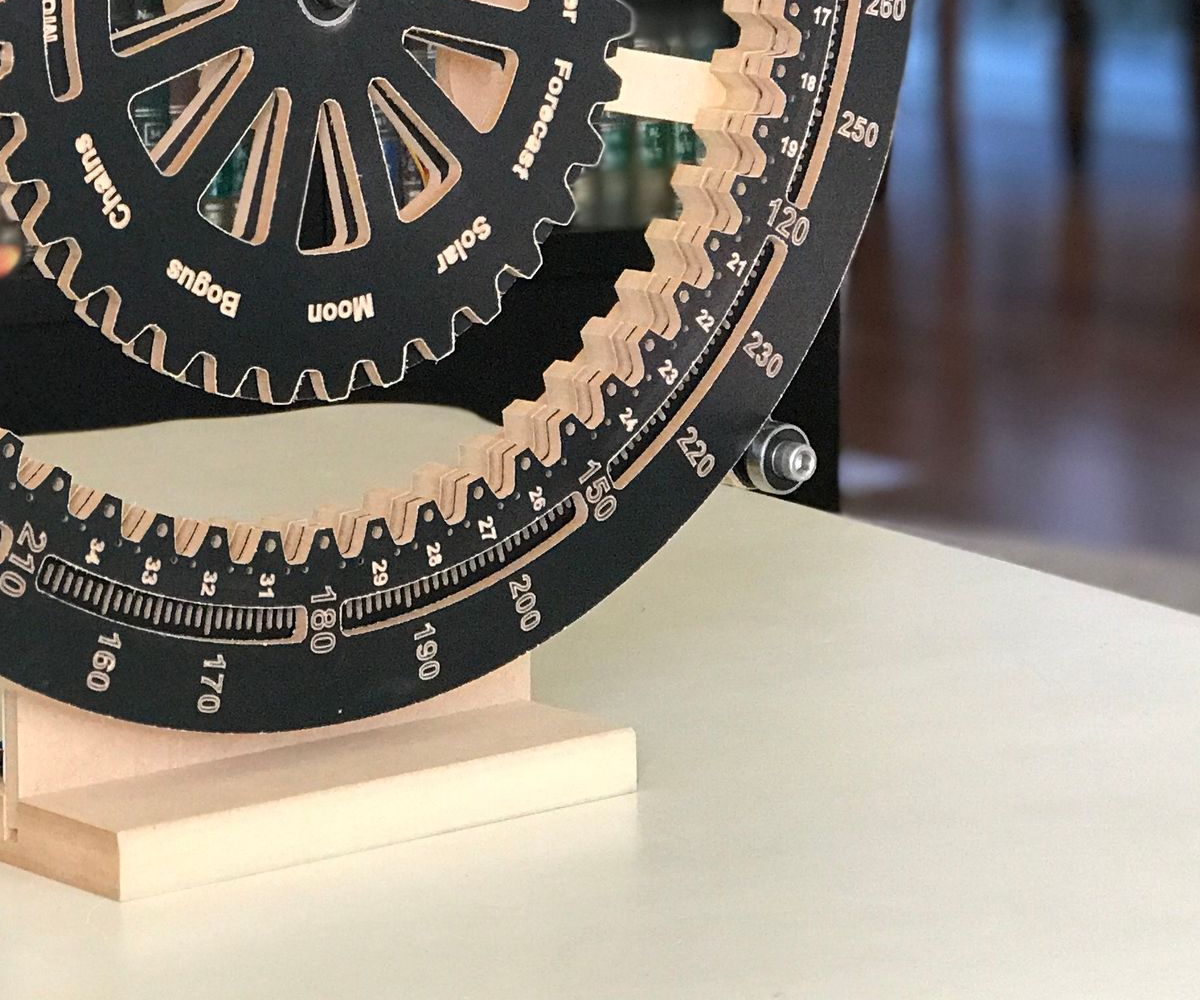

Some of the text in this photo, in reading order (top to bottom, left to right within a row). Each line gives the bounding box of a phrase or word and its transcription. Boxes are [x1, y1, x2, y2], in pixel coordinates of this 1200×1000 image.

[813, 6, 832, 26] 17
[800, 72, 817, 92] 18
[837, 110, 879, 148] 250
[780, 136, 798, 158] 19
[74, 133, 131, 230] Chains
[766, 198, 810, 246] 120
[436, 215, 492, 275] Solar
[726, 252, 747, 277] 21
[166, 258, 241, 319] Bogus
[307, 292, 375, 323] Moon
[695, 309, 715, 334] 22
[743, 331, 783, 379] 230
[657, 359, 679, 386] 23
[619, 407, 638, 432] 24
[676, 426, 716, 478] 220
[528, 486, 546, 511] 26
[578, 459, 618, 522] 150
[478, 515, 498, 540] 27
[0, 520, 48, 598] 210
[84, 537, 106, 566] 34
[426, 541, 443, 568] 28
[141, 556, 162, 586] 33
[200, 570, 218, 597] 32
[258, 572, 276, 599] 31
[371, 558, 389, 587] 29
[508, 573, 541, 632] 200
[310, 585, 337, 655] 180
[86, 632, 122, 692] 160
[413, 622, 441, 681] 190
[197, 654, 226, 714] 170
